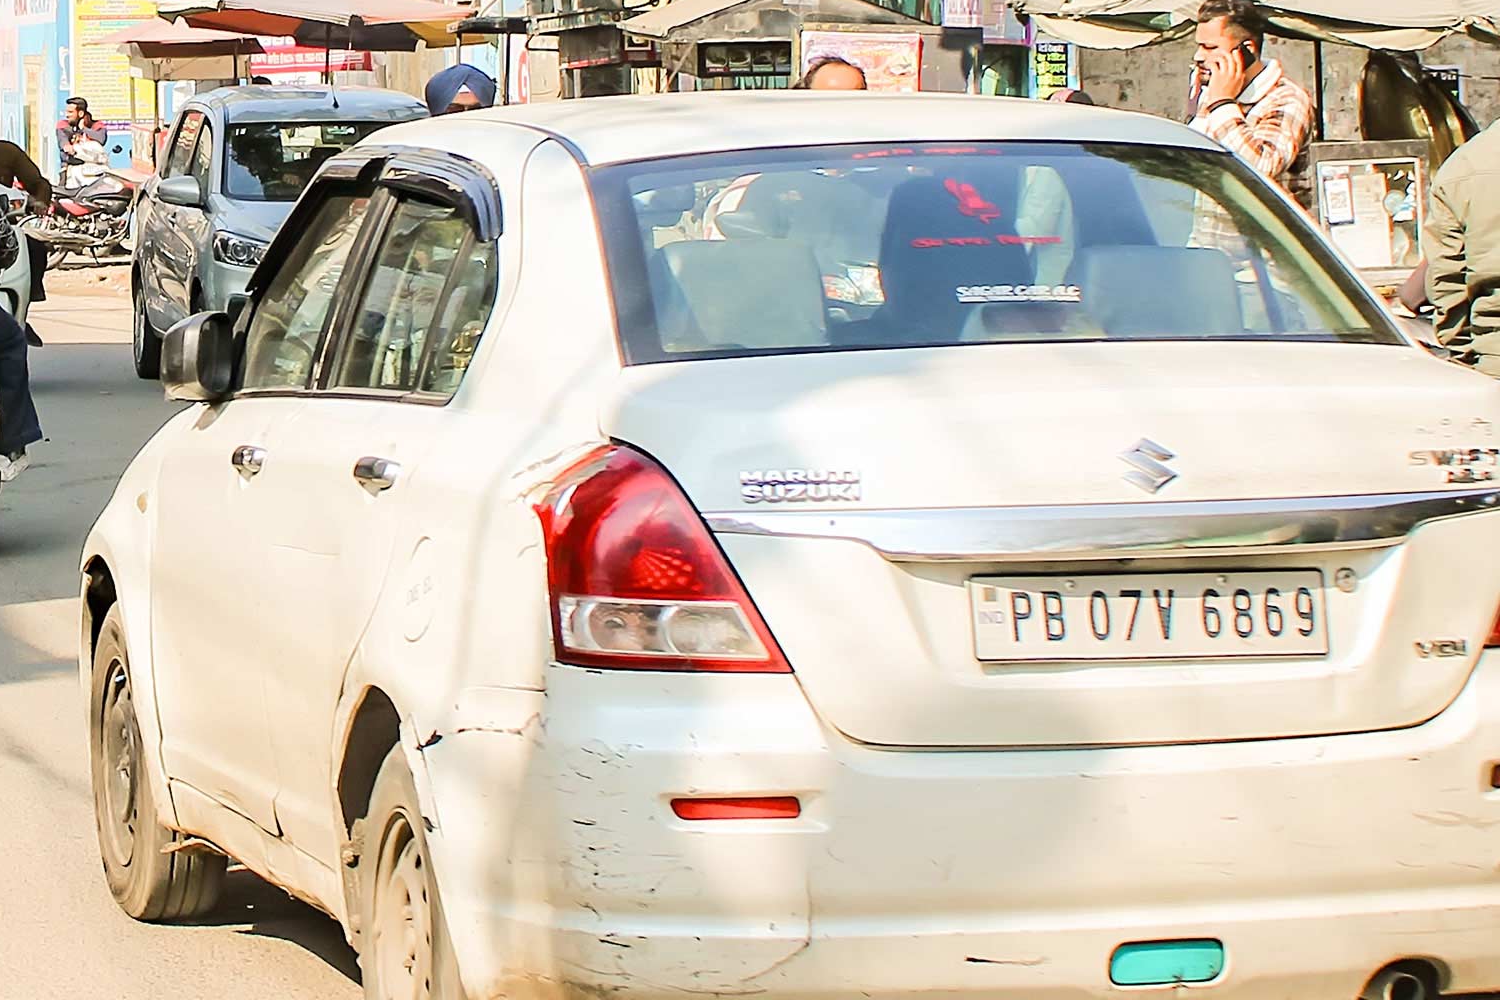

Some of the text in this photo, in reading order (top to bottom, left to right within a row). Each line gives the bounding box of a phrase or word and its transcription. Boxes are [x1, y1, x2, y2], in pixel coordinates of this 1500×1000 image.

[739, 469, 861, 486] MARUTI
[740, 483, 861, 504] SUZUKI
[1011, 586, 1314, 642] PB 07V 6869
